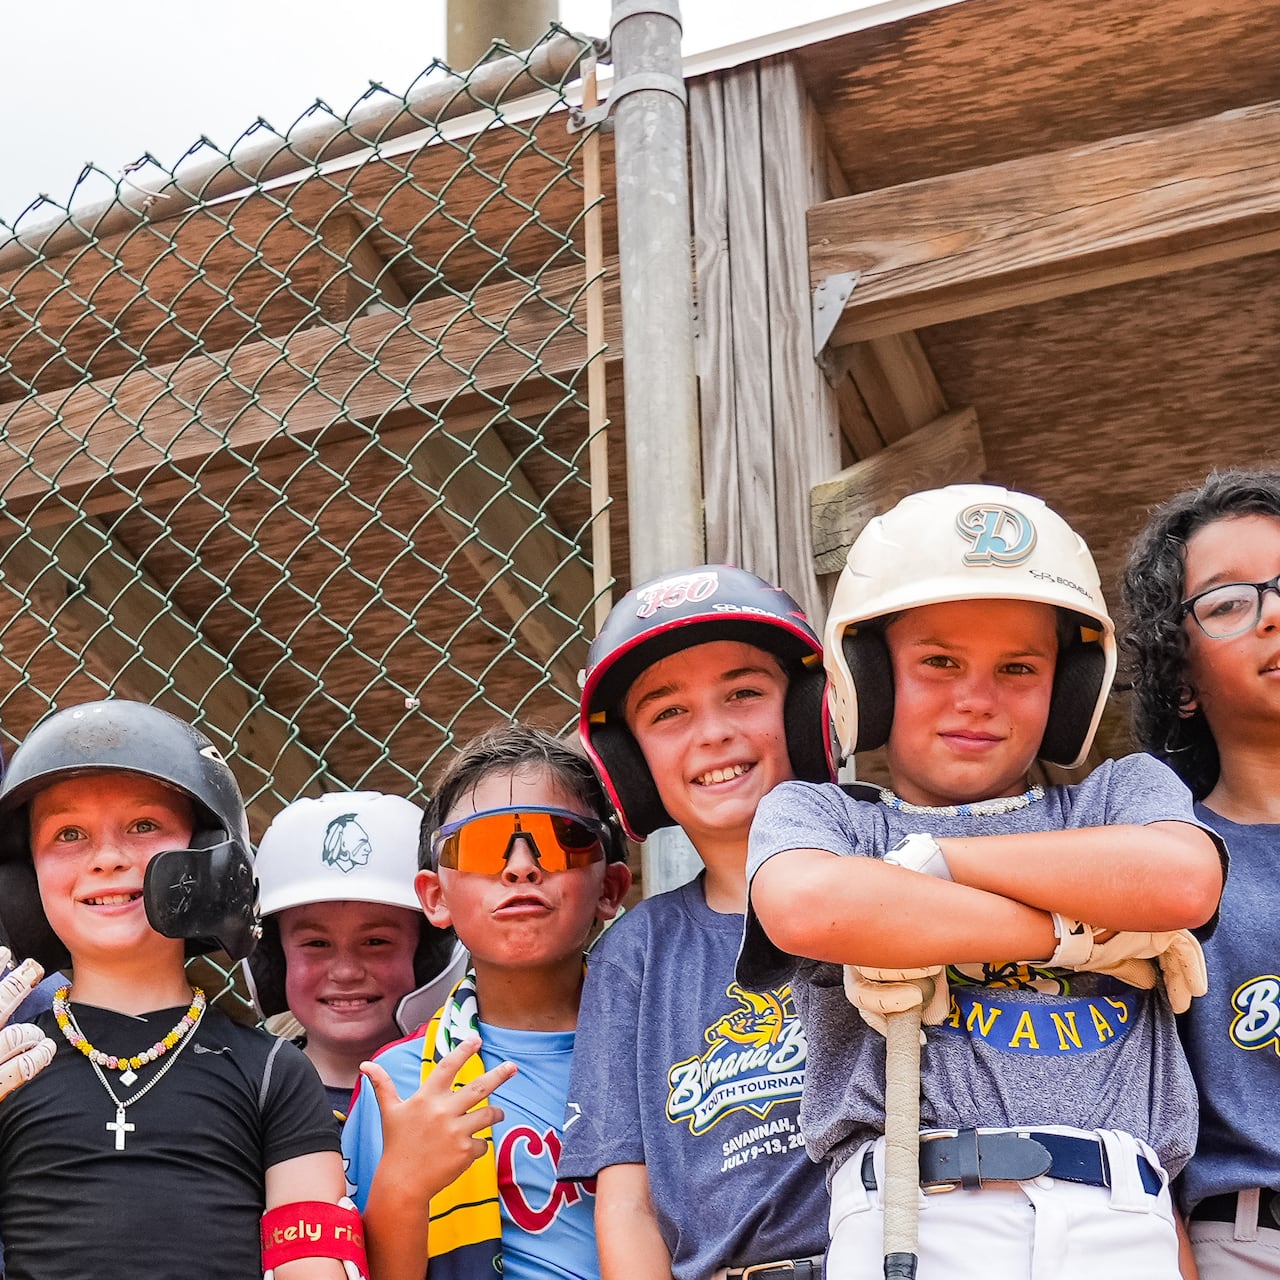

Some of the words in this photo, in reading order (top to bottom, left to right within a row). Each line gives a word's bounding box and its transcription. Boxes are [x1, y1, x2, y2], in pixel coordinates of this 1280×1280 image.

[955, 503, 1037, 567] D
[700, 1085, 736, 1116] YOUTH
[720, 1150, 751, 1173] JULY
[750, 1138, 787, 1160] 9-13,
[722, 1118, 795, 1157] SAVANNAH,
